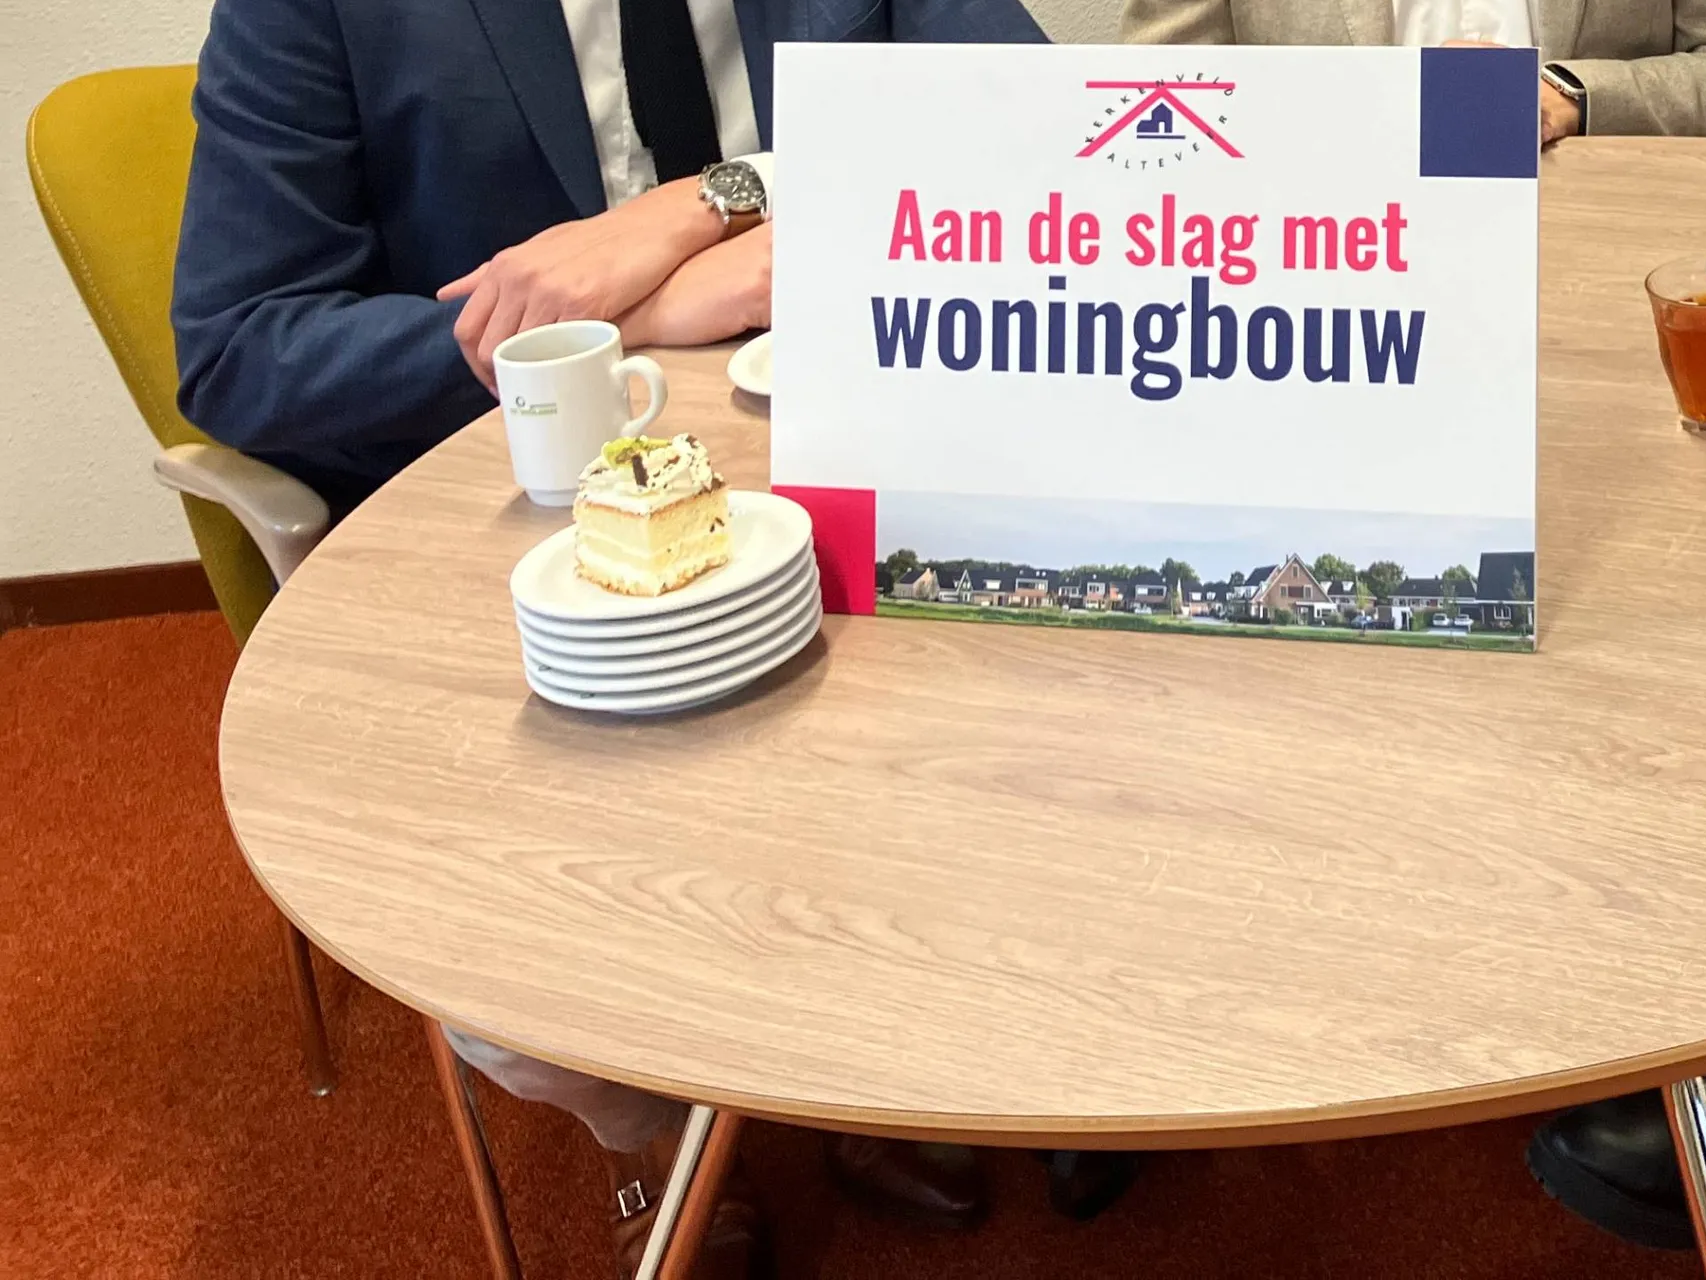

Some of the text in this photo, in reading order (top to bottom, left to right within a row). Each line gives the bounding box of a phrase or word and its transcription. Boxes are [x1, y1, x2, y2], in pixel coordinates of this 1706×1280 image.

[1085, 72, 1234, 144] KERKENVELD
[1107, 115, 1227, 170] ALTEVEER
[888, 189, 1409, 286] Aan de slag met
[871, 276, 1427, 402] woningbouw
